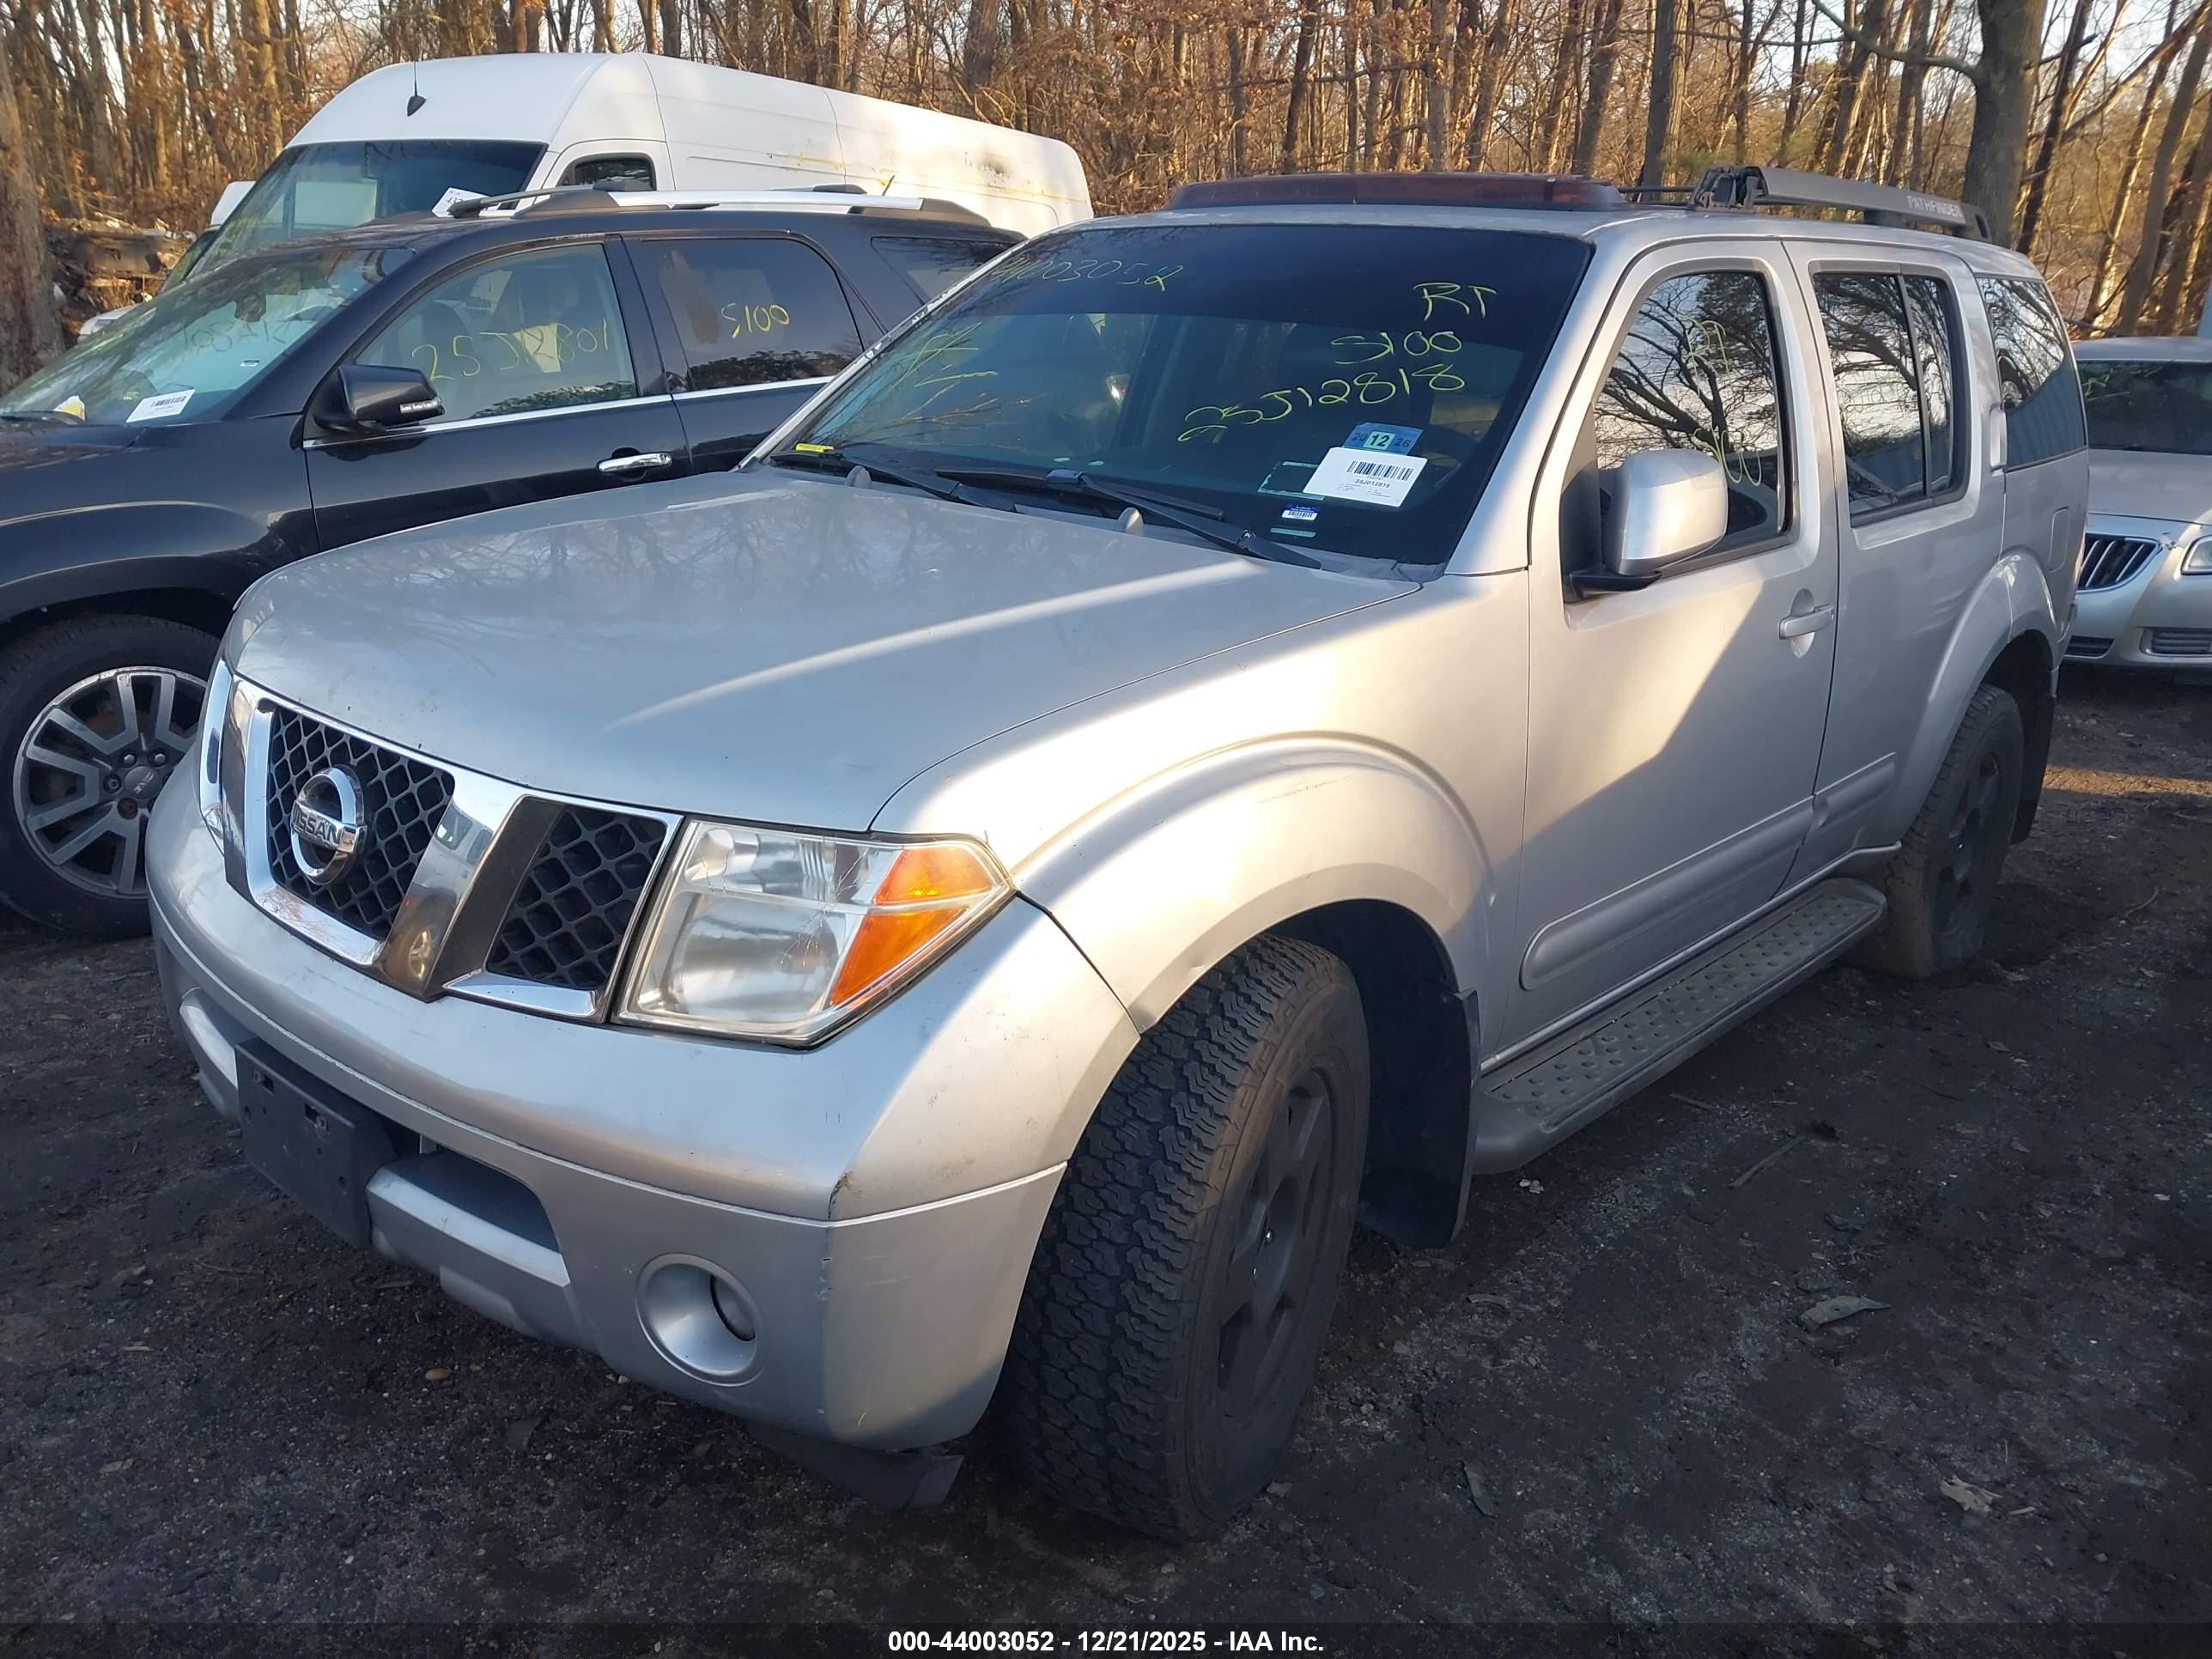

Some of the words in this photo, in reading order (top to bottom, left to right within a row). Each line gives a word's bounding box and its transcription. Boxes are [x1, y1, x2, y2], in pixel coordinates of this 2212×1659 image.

[1907, 195, 1964, 218] PATHFINDER
[1413, 282, 1497, 321] RT
[721, 302, 790, 339] S100
[1331, 331, 1462, 365] S100
[1177, 363, 1465, 442] 25J12818
[1369, 434, 1390, 447] 12
[1394, 437, 1412, 447] 26
